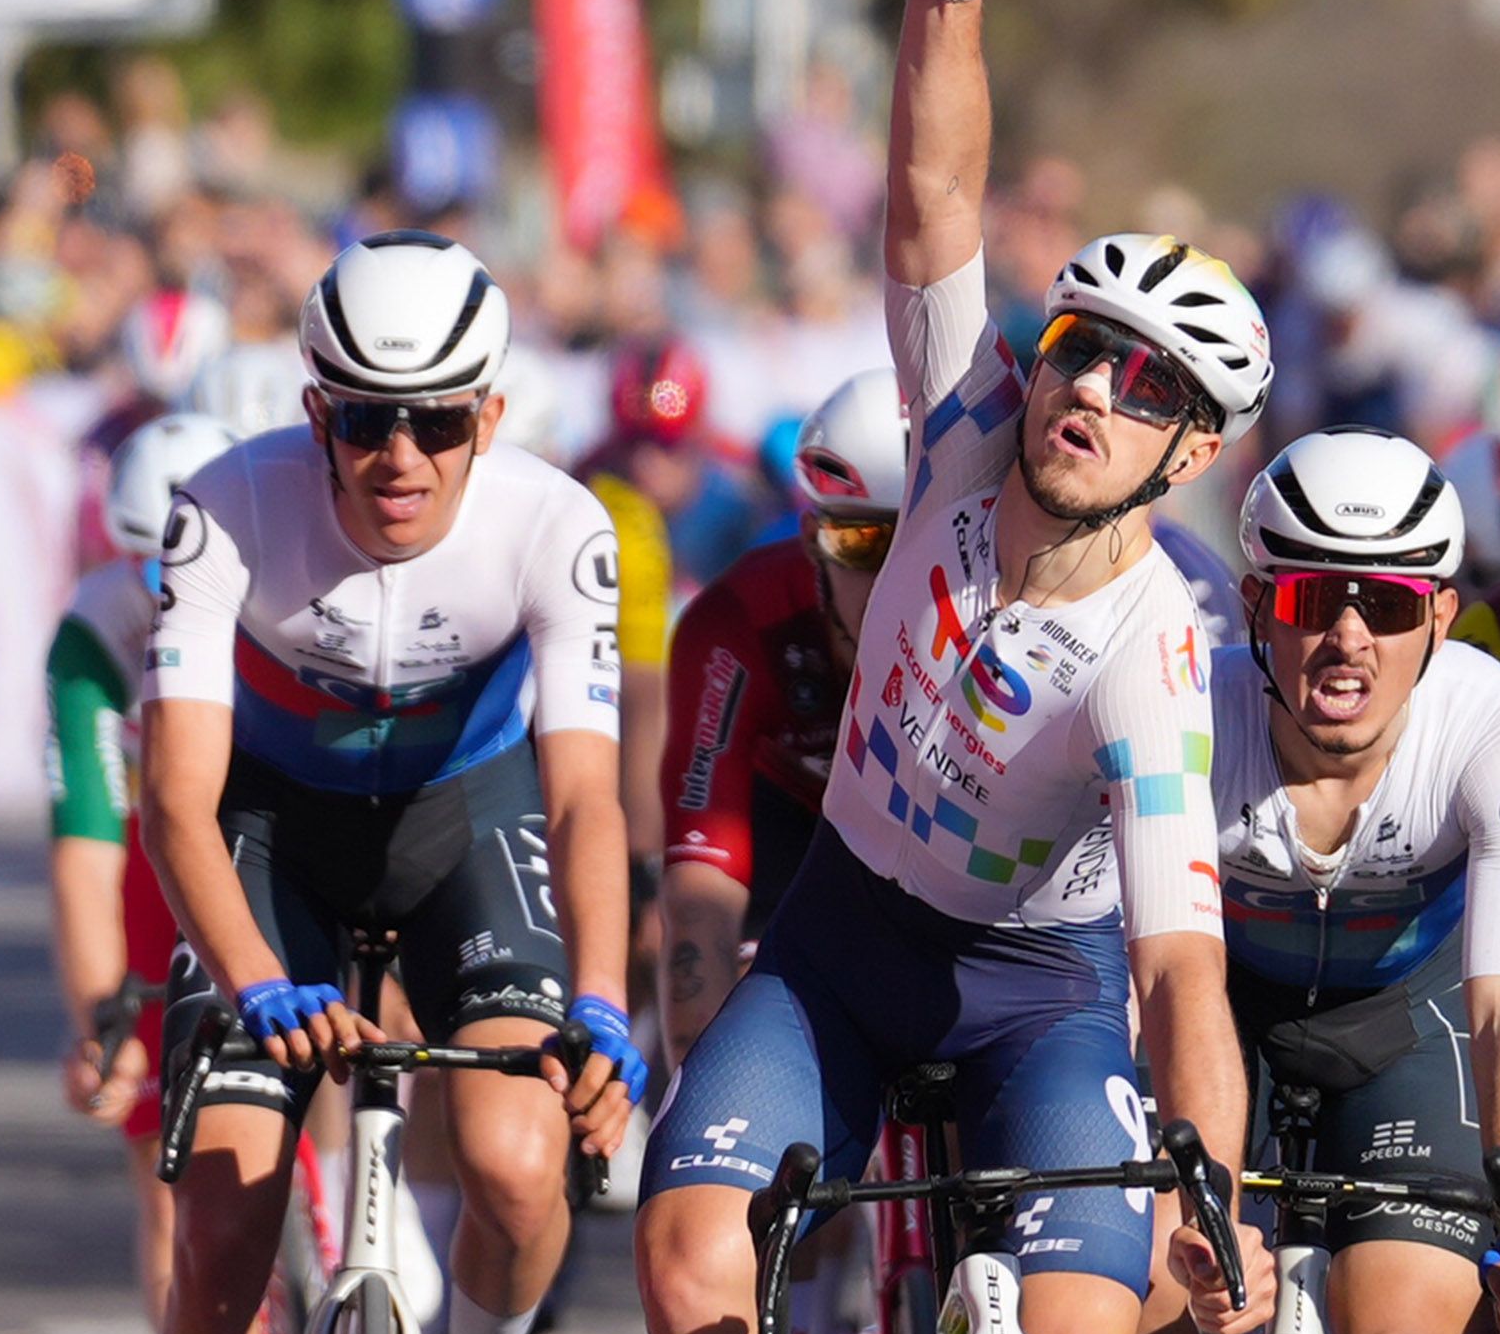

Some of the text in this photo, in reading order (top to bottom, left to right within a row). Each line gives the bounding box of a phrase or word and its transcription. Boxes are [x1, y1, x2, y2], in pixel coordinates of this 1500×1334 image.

[1343, 506, 1378, 516] ABUS
[1040, 619, 1098, 666] BIORACER
[1059, 658, 1077, 676] UCI
[1049, 675, 1072, 698] TEAM
[899, 703, 992, 804] VENDÉE
[1360, 1145, 1431, 1164] SPEED LM
[670, 1155, 775, 1182] CUBE
[364, 1142, 382, 1246] LOOK
[1412, 1217, 1475, 1245] GESTION
